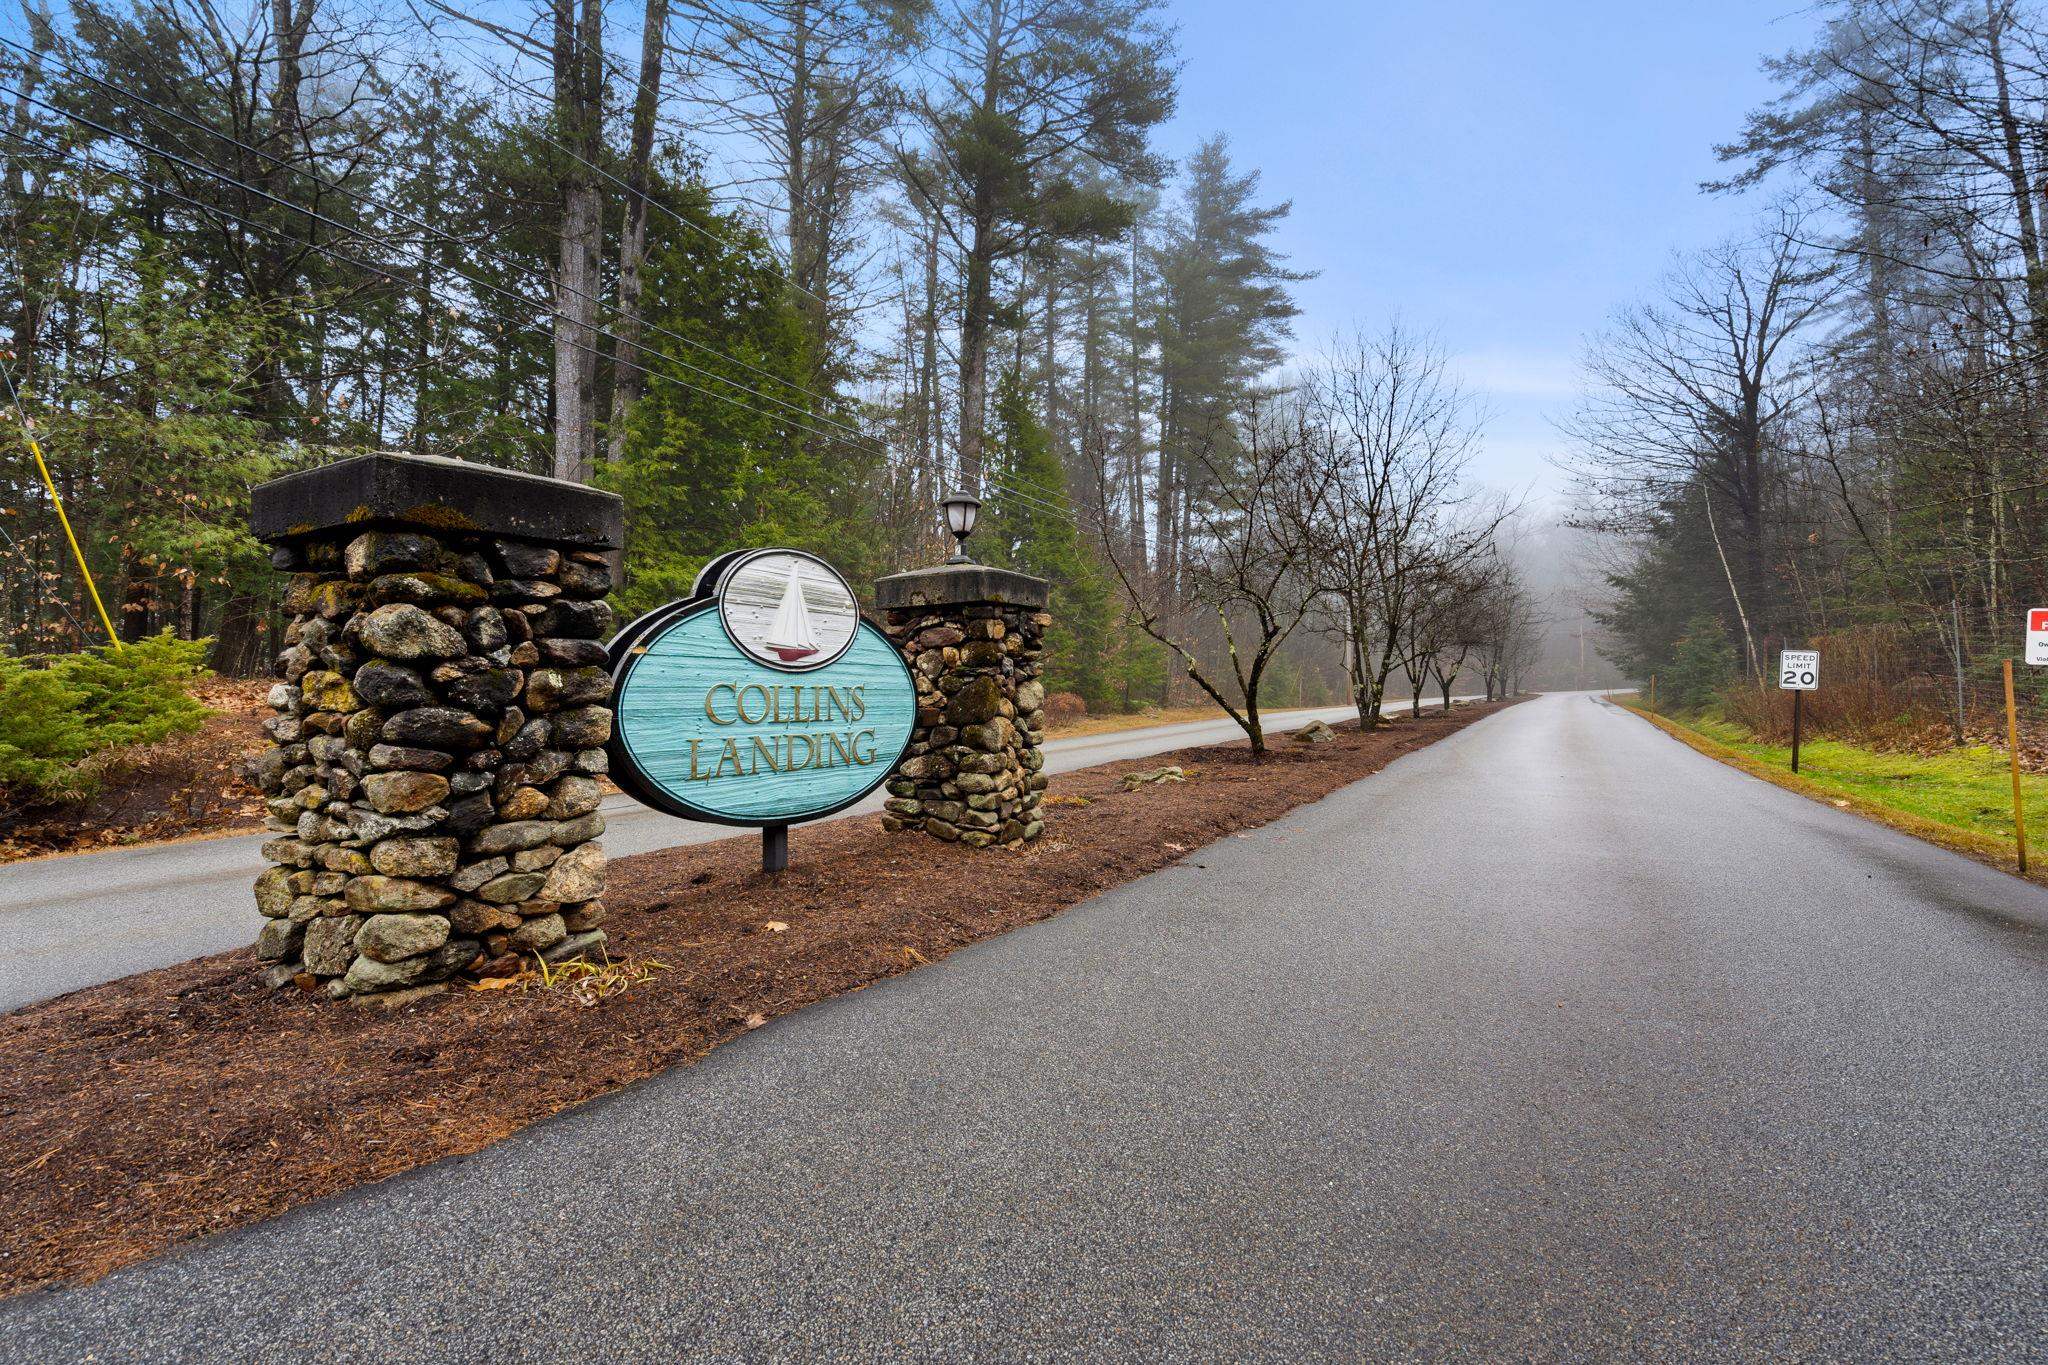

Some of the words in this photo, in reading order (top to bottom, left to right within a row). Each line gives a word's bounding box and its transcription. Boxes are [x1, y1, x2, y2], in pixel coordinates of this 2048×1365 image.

[1783, 670, 1815, 685] 20
[705, 680, 866, 728] COLLINS
[686, 728, 877, 784] LANDING
